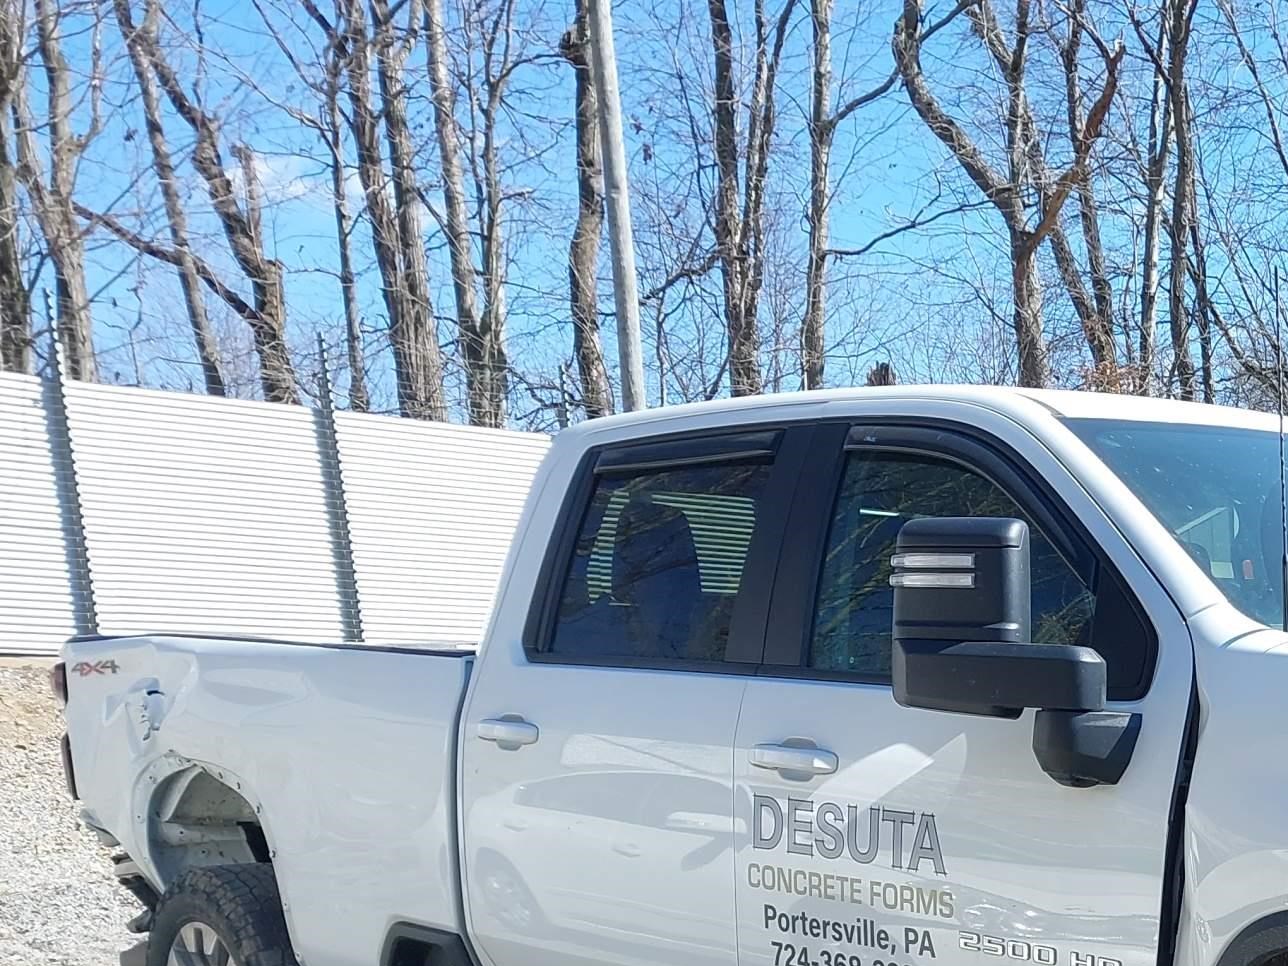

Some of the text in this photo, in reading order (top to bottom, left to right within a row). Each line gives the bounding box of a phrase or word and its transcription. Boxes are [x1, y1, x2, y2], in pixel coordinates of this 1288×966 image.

[752, 791, 948, 876] DESUTA
[747, 862, 954, 919] CONCRETE FORMS
[763, 903, 936, 959] Portersville, PA
[958, 929, 1057, 966] 2500
